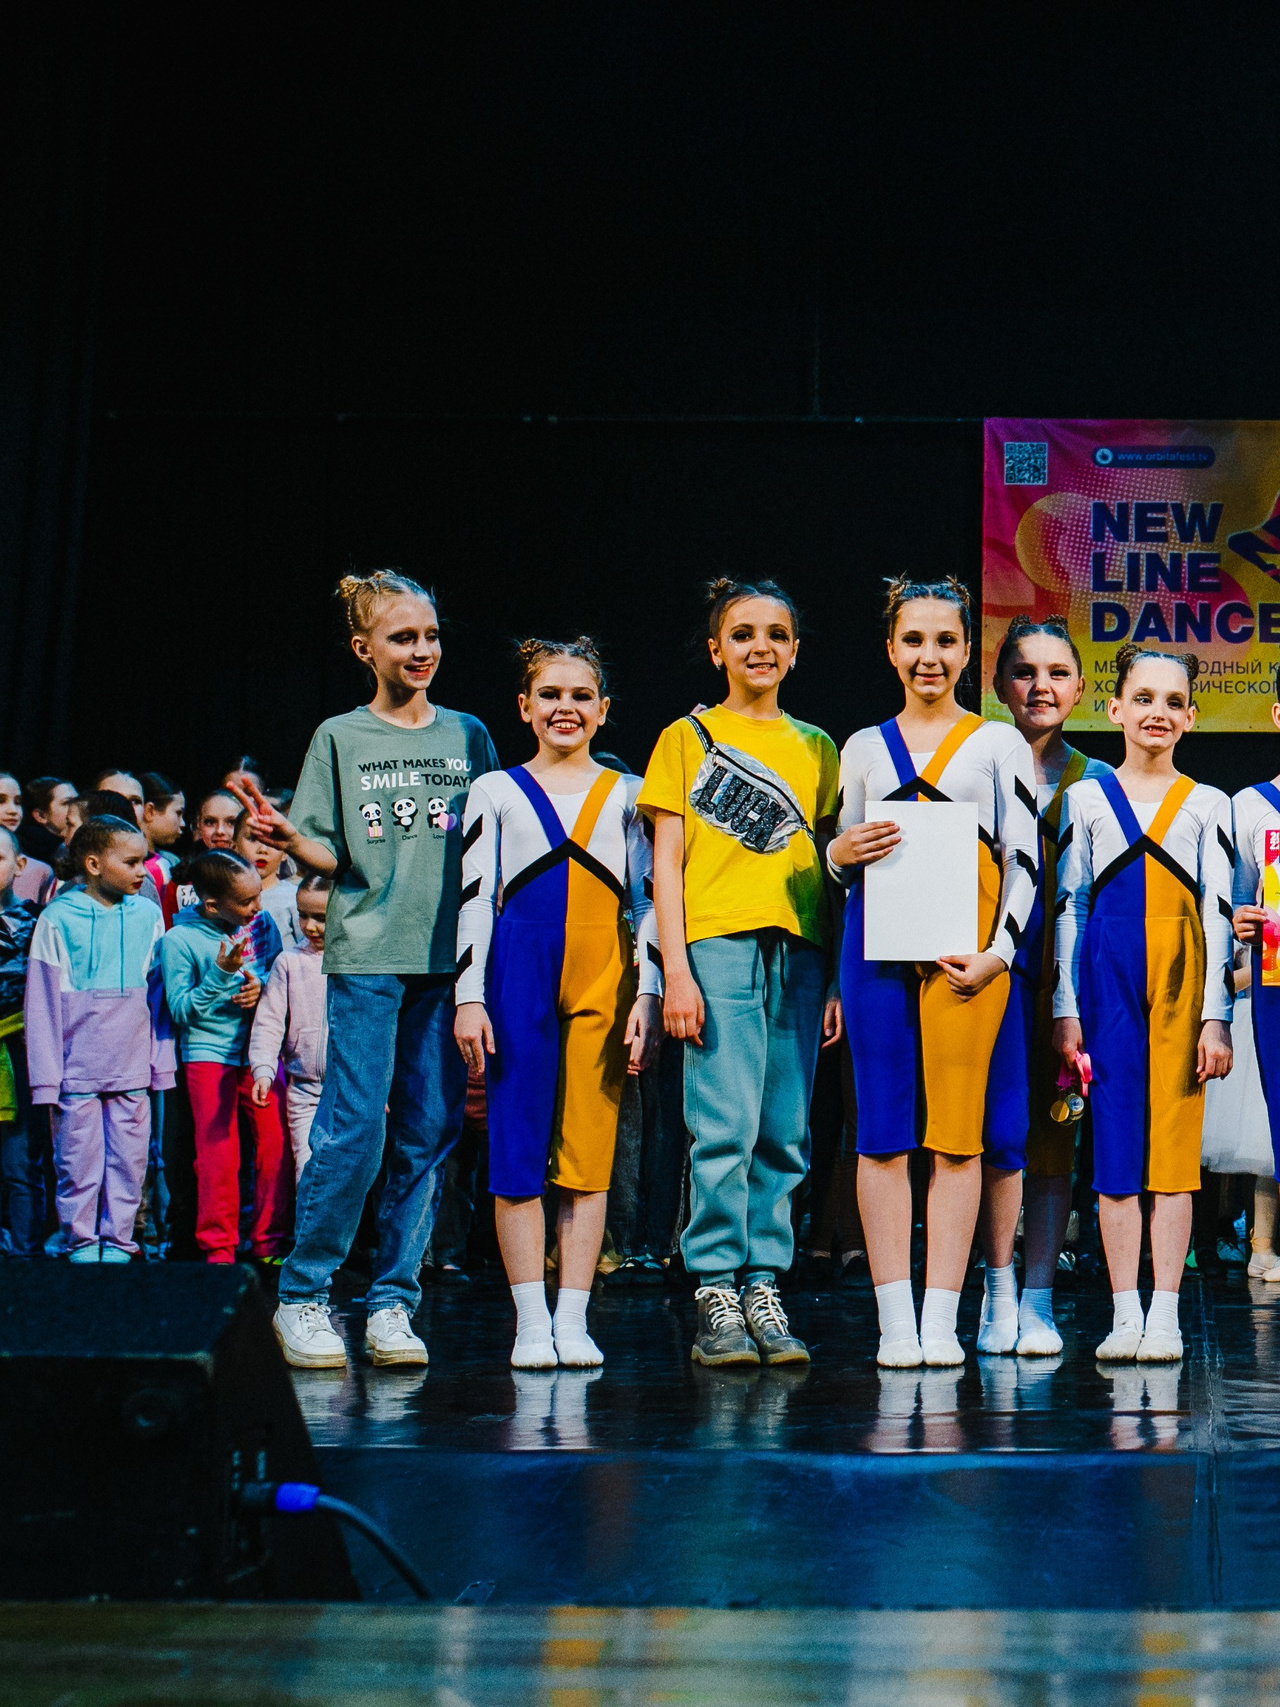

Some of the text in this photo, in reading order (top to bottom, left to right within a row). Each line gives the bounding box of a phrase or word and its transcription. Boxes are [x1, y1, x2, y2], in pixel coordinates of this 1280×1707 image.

[1092, 502, 1224, 543] NEW
[1092, 552, 1222, 593] LINE
[358, 757, 472, 773] WHAT MAKES YOU
[360, 771, 421, 791] SMILE
[696, 765, 788, 852] LUCK
